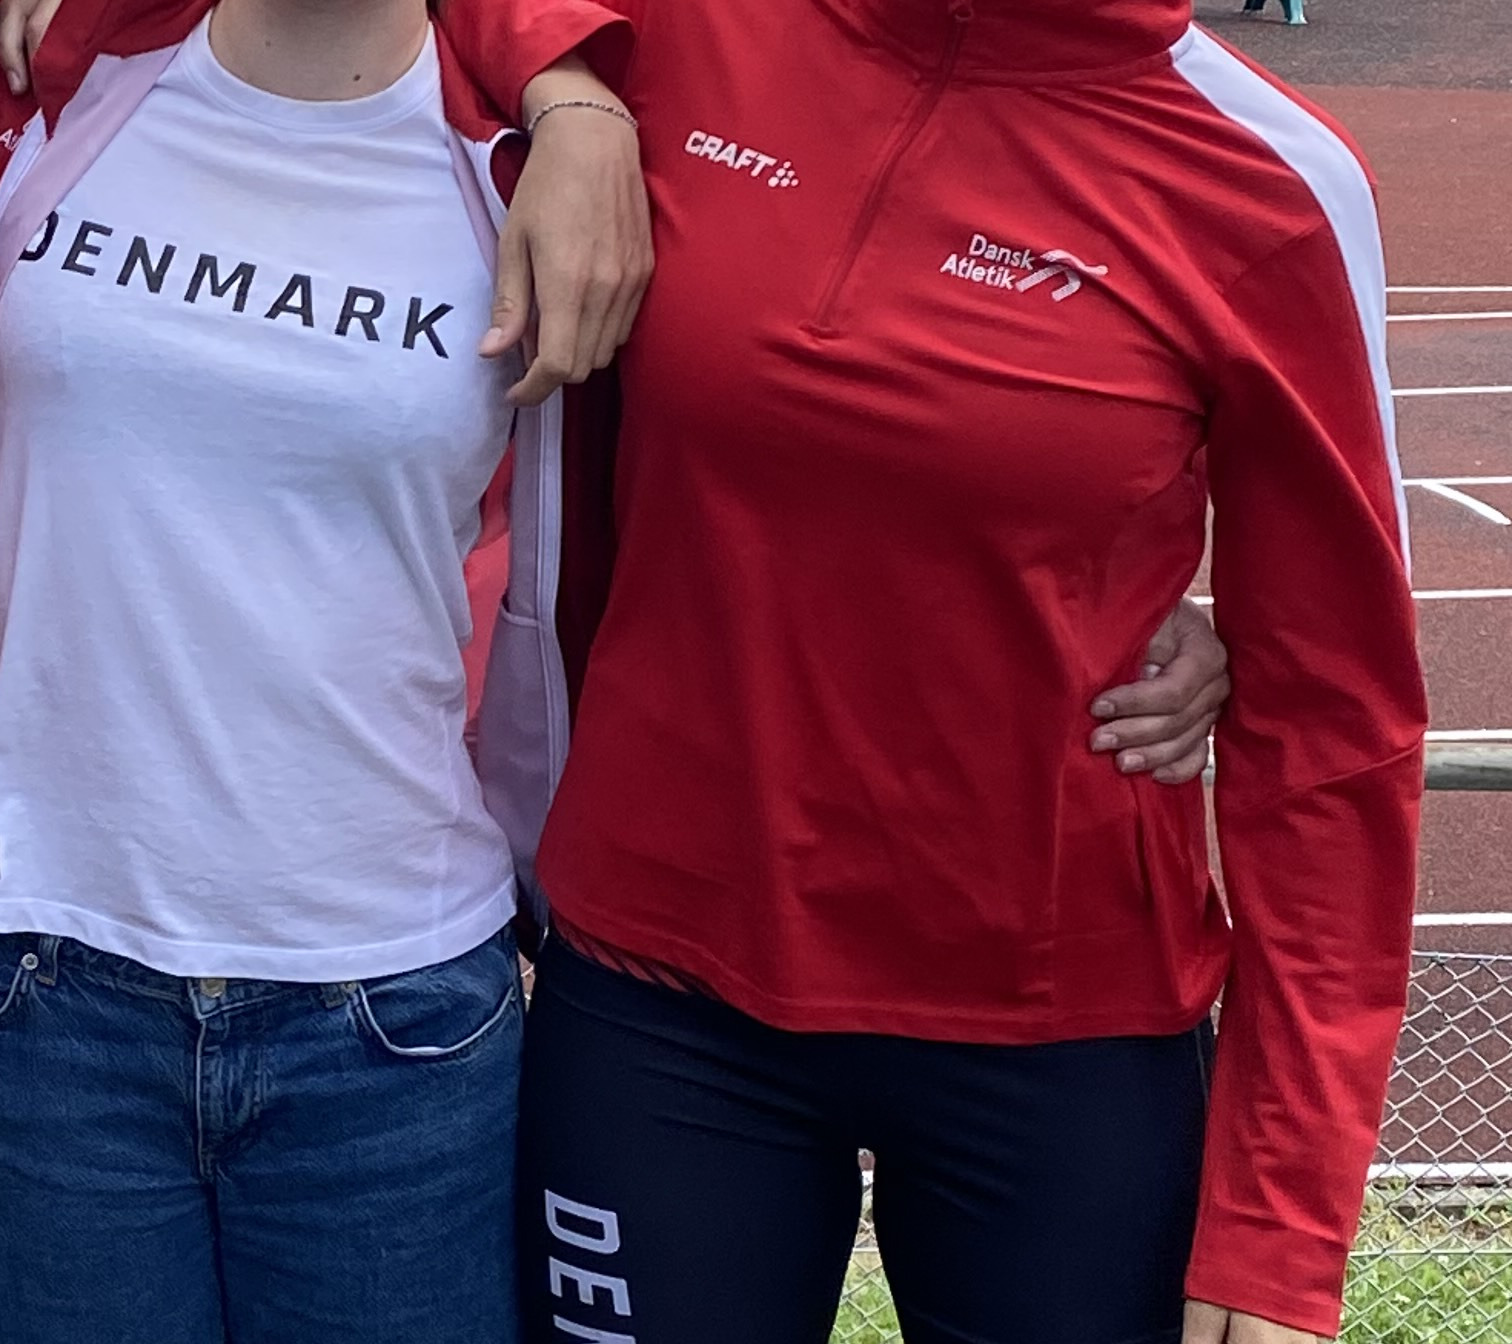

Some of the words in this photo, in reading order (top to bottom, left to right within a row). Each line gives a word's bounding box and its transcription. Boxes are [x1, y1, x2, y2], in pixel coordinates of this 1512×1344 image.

[684, 130, 778, 177] CRAFT
[969, 233, 1036, 270] Dansk
[940, 253, 1017, 290] Atletik
